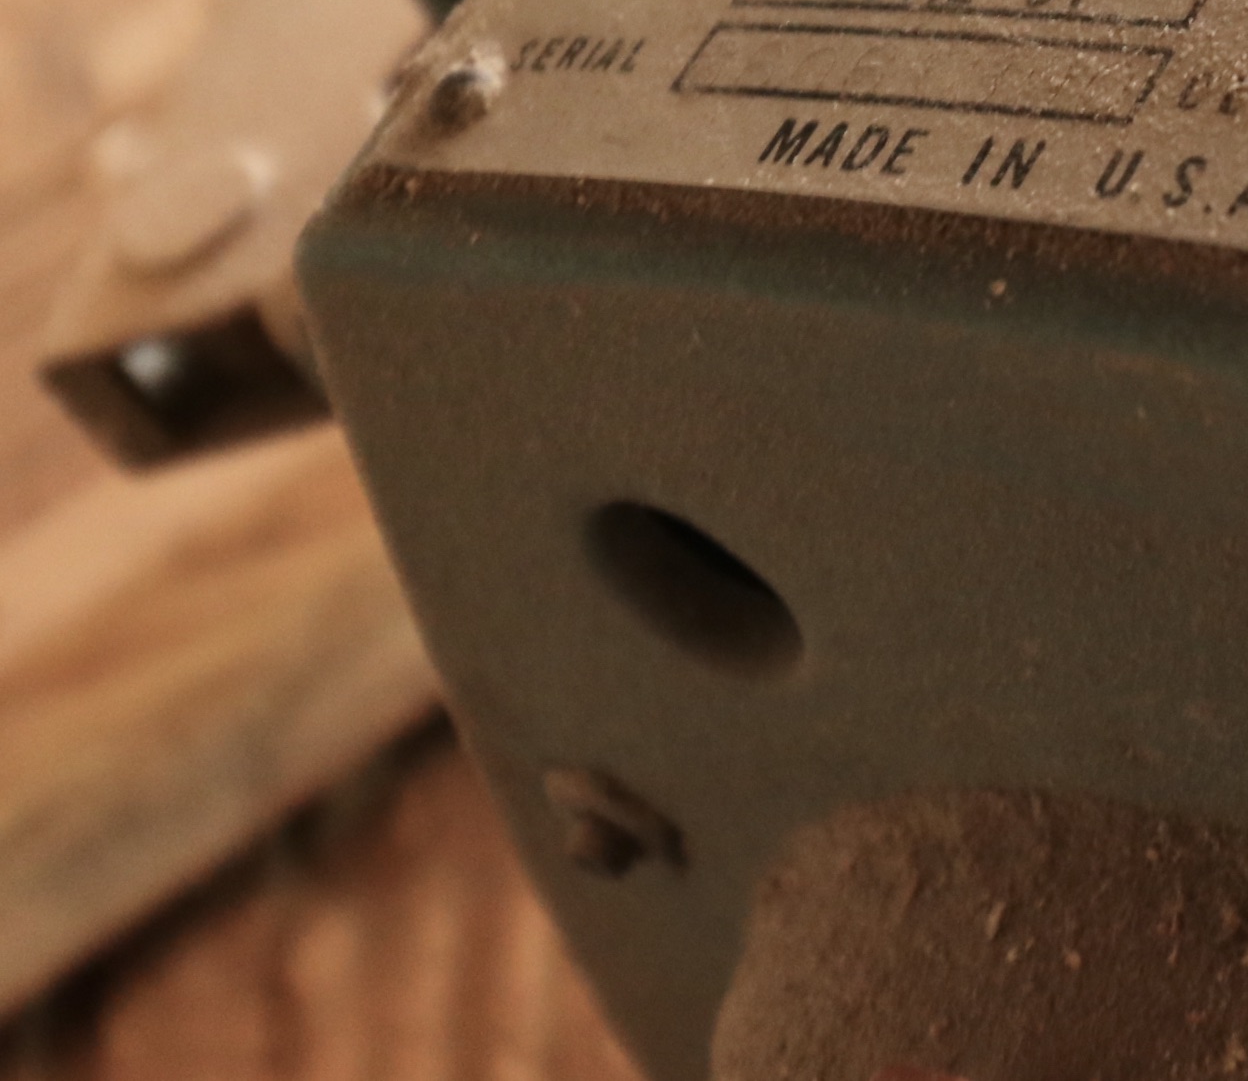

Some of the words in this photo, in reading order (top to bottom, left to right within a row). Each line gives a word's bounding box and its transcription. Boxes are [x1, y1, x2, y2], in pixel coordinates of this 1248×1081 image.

[510, 36, 648, 75] SERIAL
[757, 117, 930, 176] MADE
[960, 136, 1048, 191] IN
